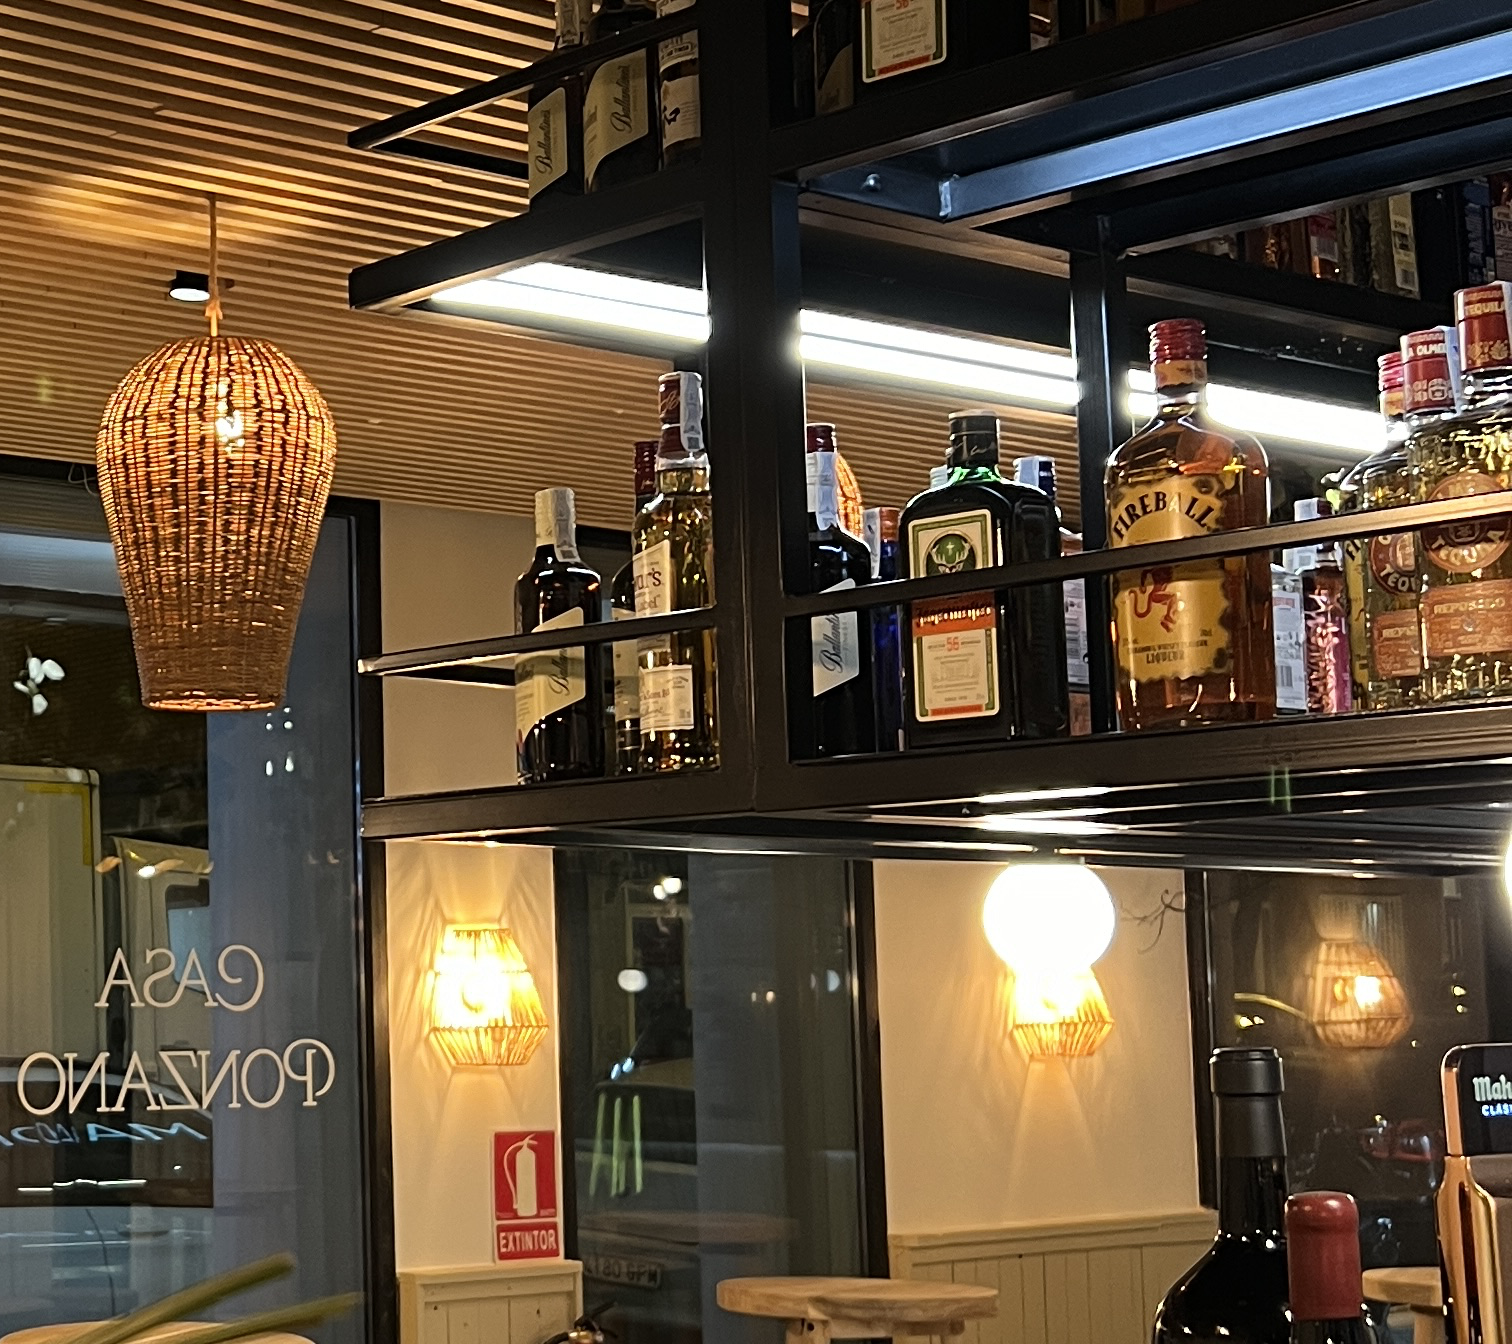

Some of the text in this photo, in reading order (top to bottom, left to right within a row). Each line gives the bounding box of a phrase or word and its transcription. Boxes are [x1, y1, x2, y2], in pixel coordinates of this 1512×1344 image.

[1112, 491, 1215, 540] FIREBALL
[946, 636, 960, 652] 56
[499, 1229, 557, 1253] EXTINTOR
